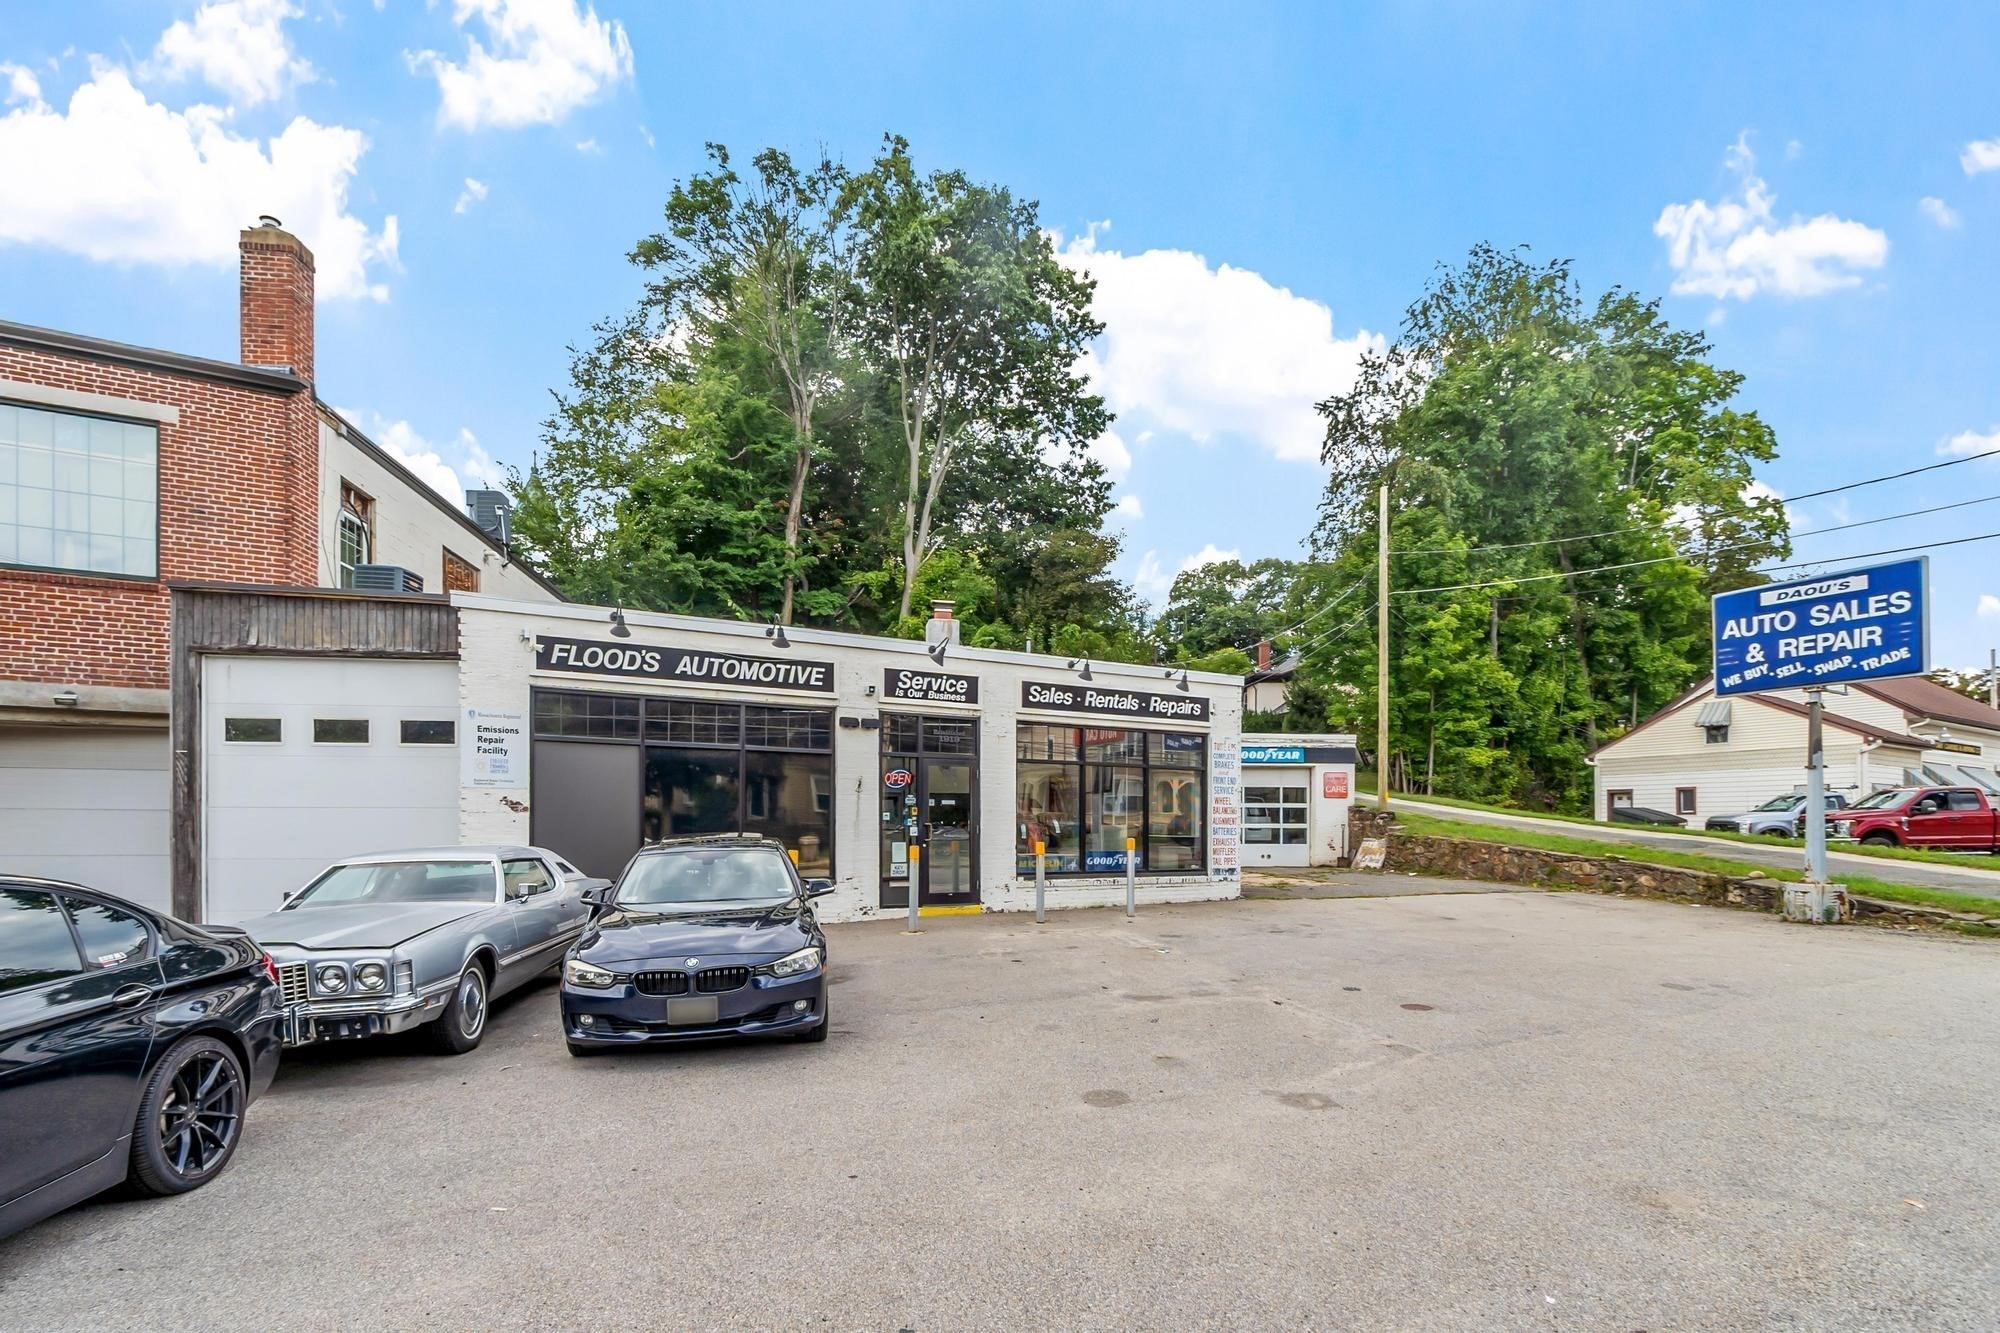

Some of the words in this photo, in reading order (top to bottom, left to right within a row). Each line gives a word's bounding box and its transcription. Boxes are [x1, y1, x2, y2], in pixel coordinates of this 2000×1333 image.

[1776, 581, 1851, 601] DAOU'S
[1721, 610, 1797, 640] AUTO
[1809, 591, 1912, 627] SALES
[1745, 643, 1765, 663] &
[1778, 626, 1883, 659] REPAIR
[551, 644, 661, 673] FLOOD'S
[675, 655, 825, 686] AUTOMOTIVE
[1722, 672, 1742, 688] WE
[1744, 664, 1769, 681] BUY
[1776, 662, 1806, 679] SELL
[1814, 655, 1853, 676] SWAP
[1860, 647, 1911, 672] TRADE
[897, 671, 968, 693] Service
[895, 688, 904, 697] Is
[907, 688, 924, 698] Our
[927, 690, 966, 702] Business
[1028, 685, 1073, 705] Sales
[1084, 691, 1139, 711] Rentals
[1149, 697, 1201, 717] Repairs
[477, 725, 519, 735] Emissions
[477, 736, 504, 745] Repair
[477, 746, 508, 756] Facility
[1241, 750, 1300, 760] OODYEAR
[1214, 760, 1234, 769] BRAKES
[885, 773, 911, 784] OPEN
[1214, 786, 1234, 795] SERVICE
[1325, 785, 1347, 793] CARE
[1214, 796, 1232, 805] WHEEL
[1212, 817, 1237, 825] ALIGNMENT
[1212, 827, 1237, 836] BATTERIES
[1212, 847, 1236, 856] MUFFLERS
